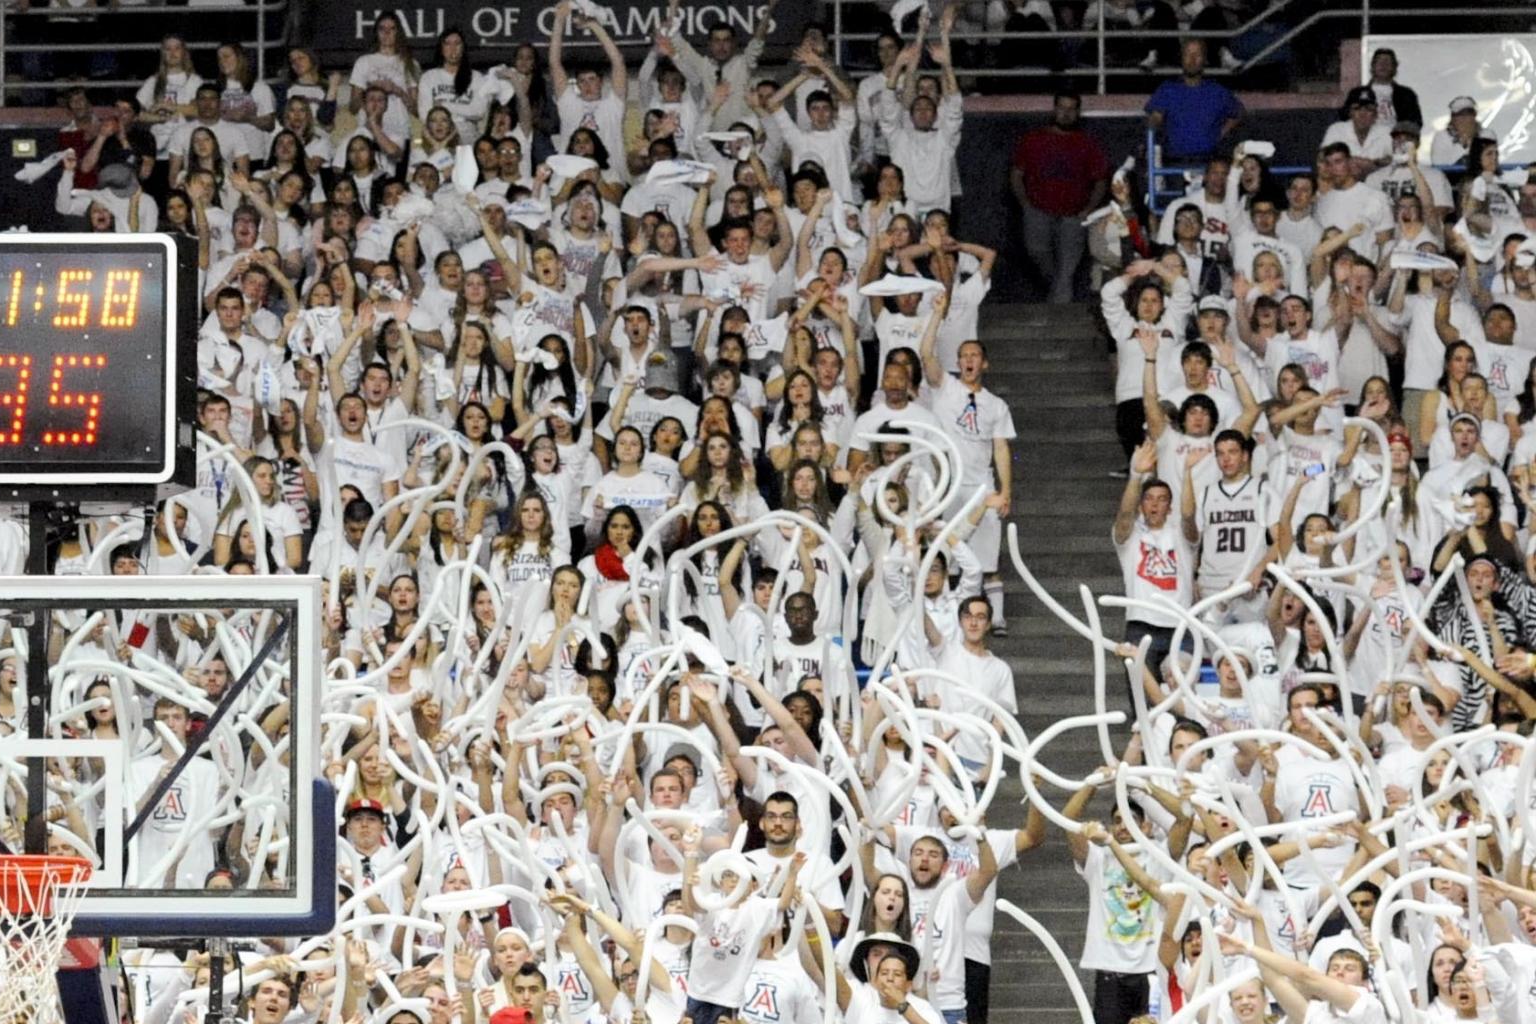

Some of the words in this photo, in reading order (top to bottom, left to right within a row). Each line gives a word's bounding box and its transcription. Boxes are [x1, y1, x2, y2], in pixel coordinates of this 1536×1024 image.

[472, 8, 521, 37] OF
[6, 268, 142, 329] 1:58
[1208, 509, 1256, 525] ARIZONA
[1214, 527, 1244, 553] 20
[152, 786, 187, 821] A
[1300, 784, 1336, 818] A
[743, 983, 780, 1022] A
